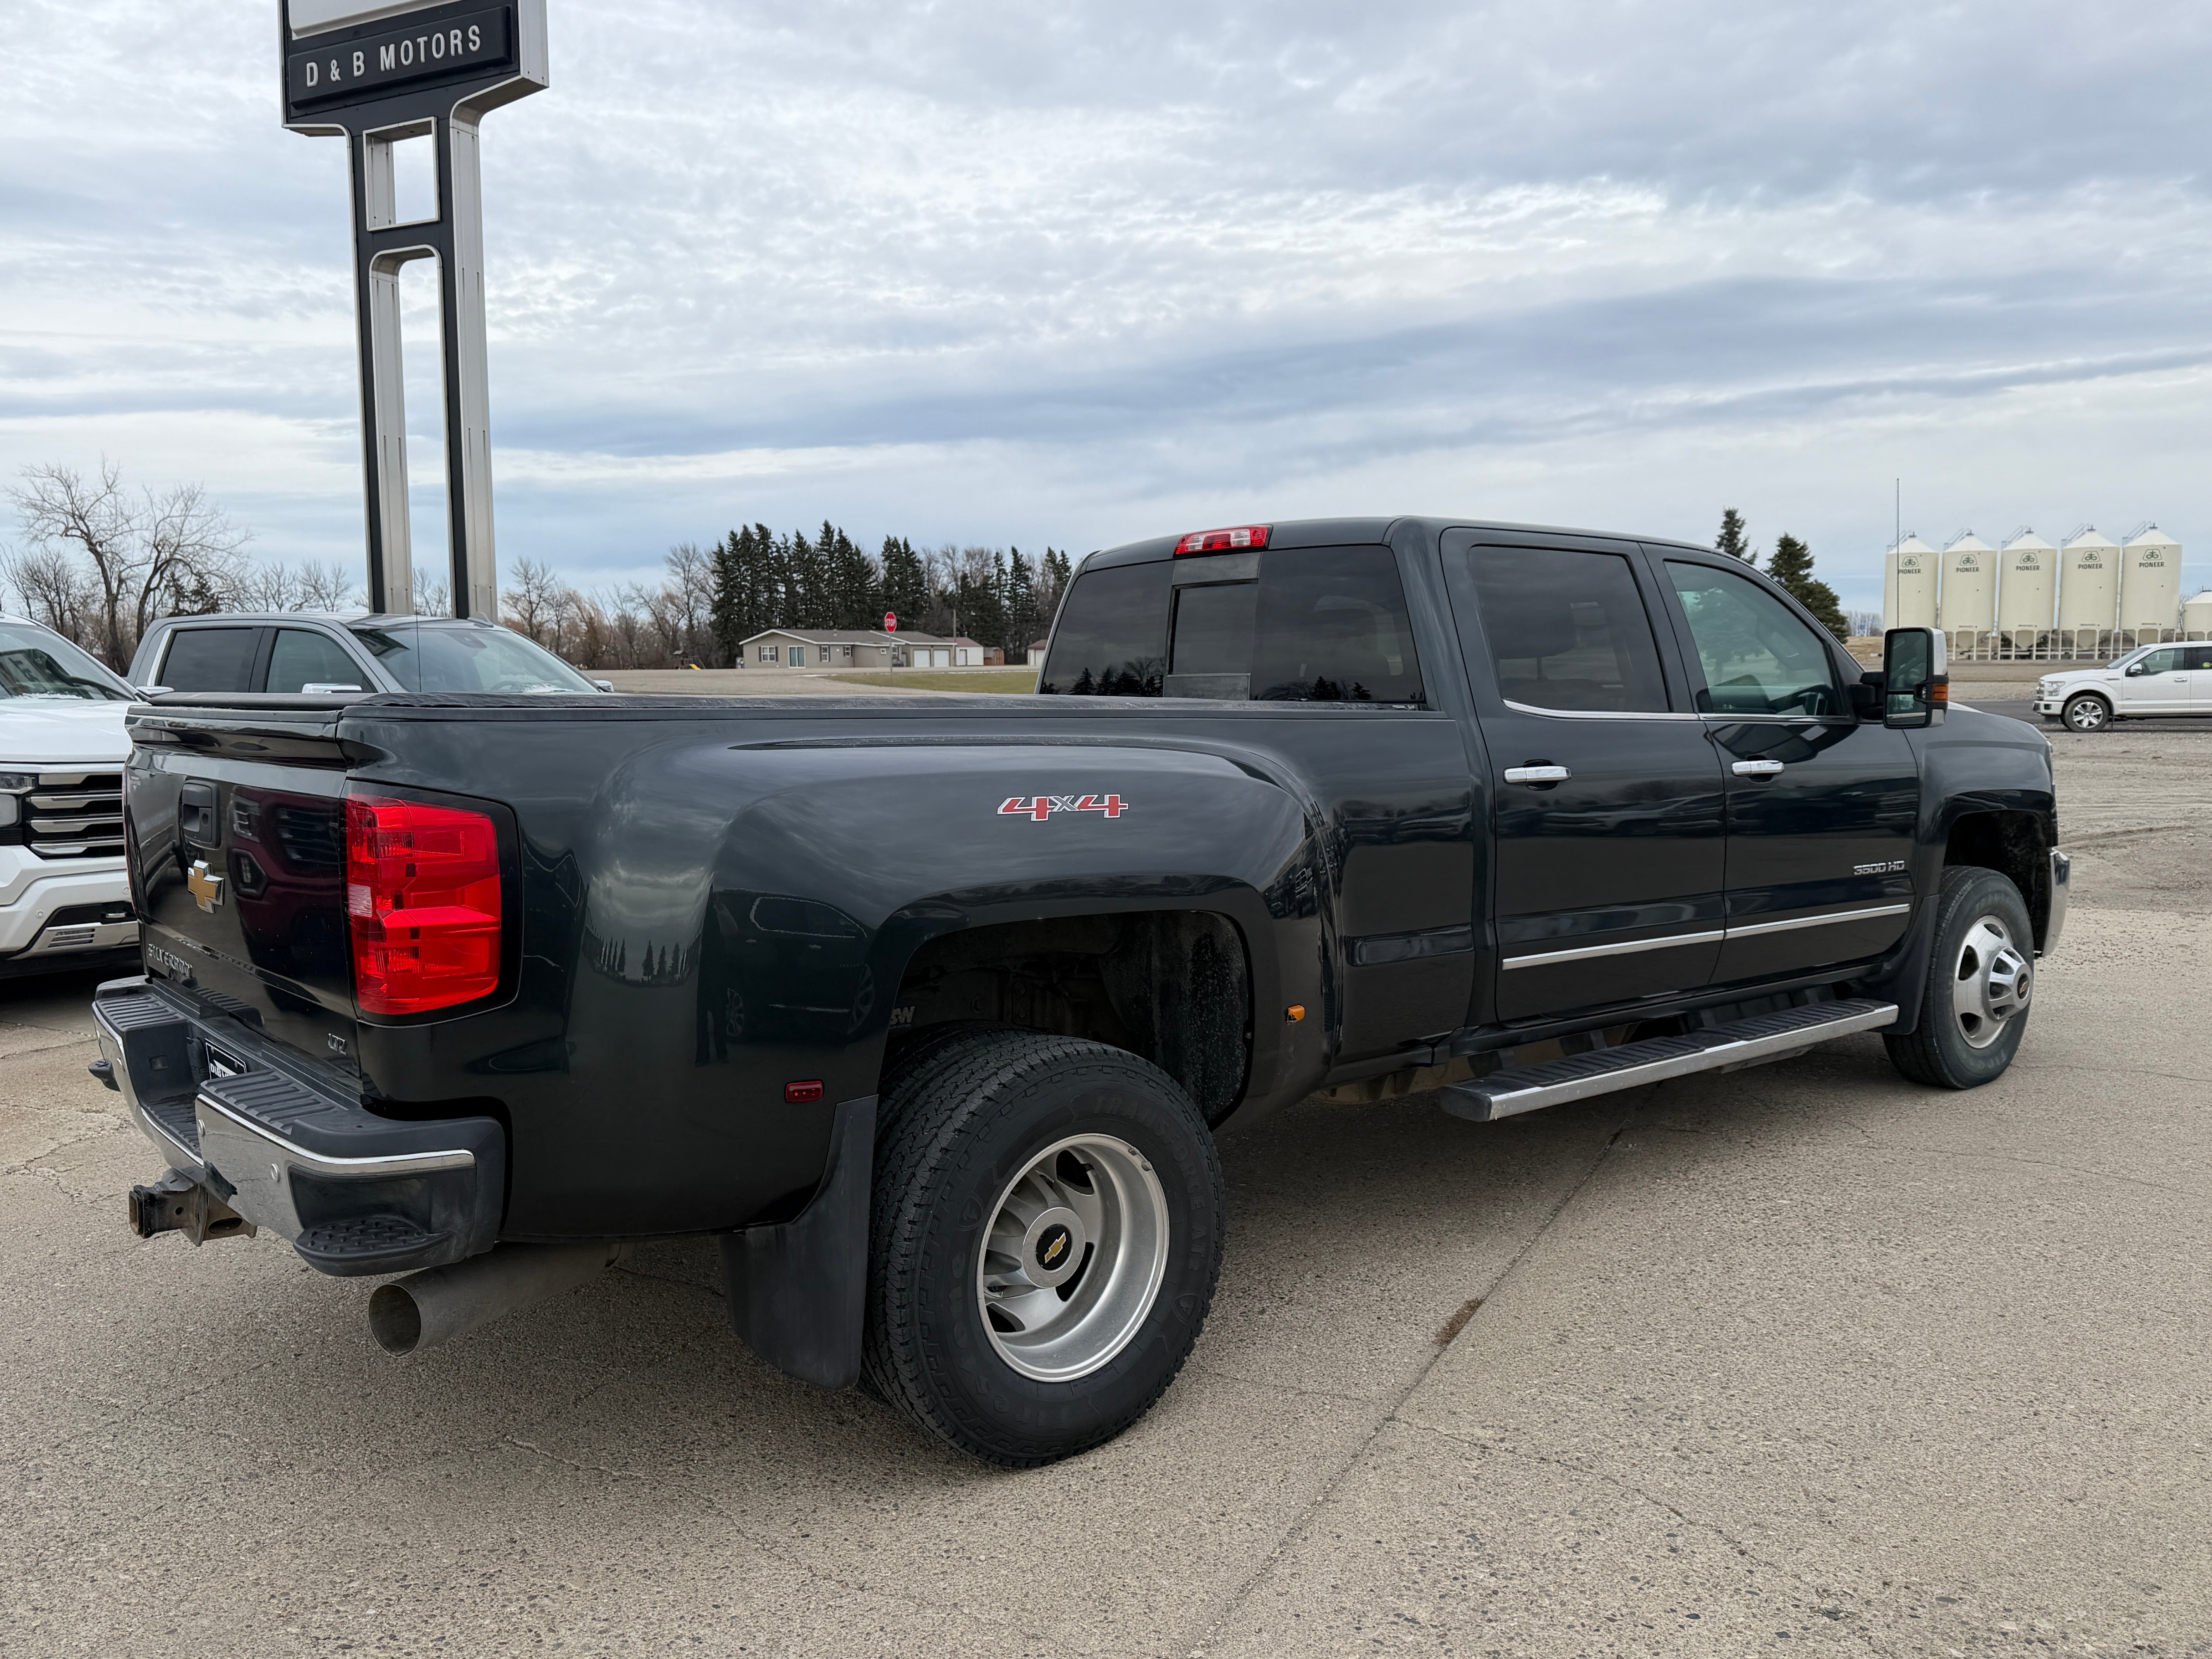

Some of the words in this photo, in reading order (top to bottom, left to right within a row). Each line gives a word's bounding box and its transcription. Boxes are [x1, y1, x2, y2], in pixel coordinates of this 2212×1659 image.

[306, 62, 319, 88] D
[330, 59, 341, 82] &
[353, 51, 365, 77] B
[380, 25, 481, 72] MOTORS
[885, 618, 896, 627] STOP
[1888, 860, 1905, 872] HD
[1093, 1093, 1207, 1211] TRANSFORCE
